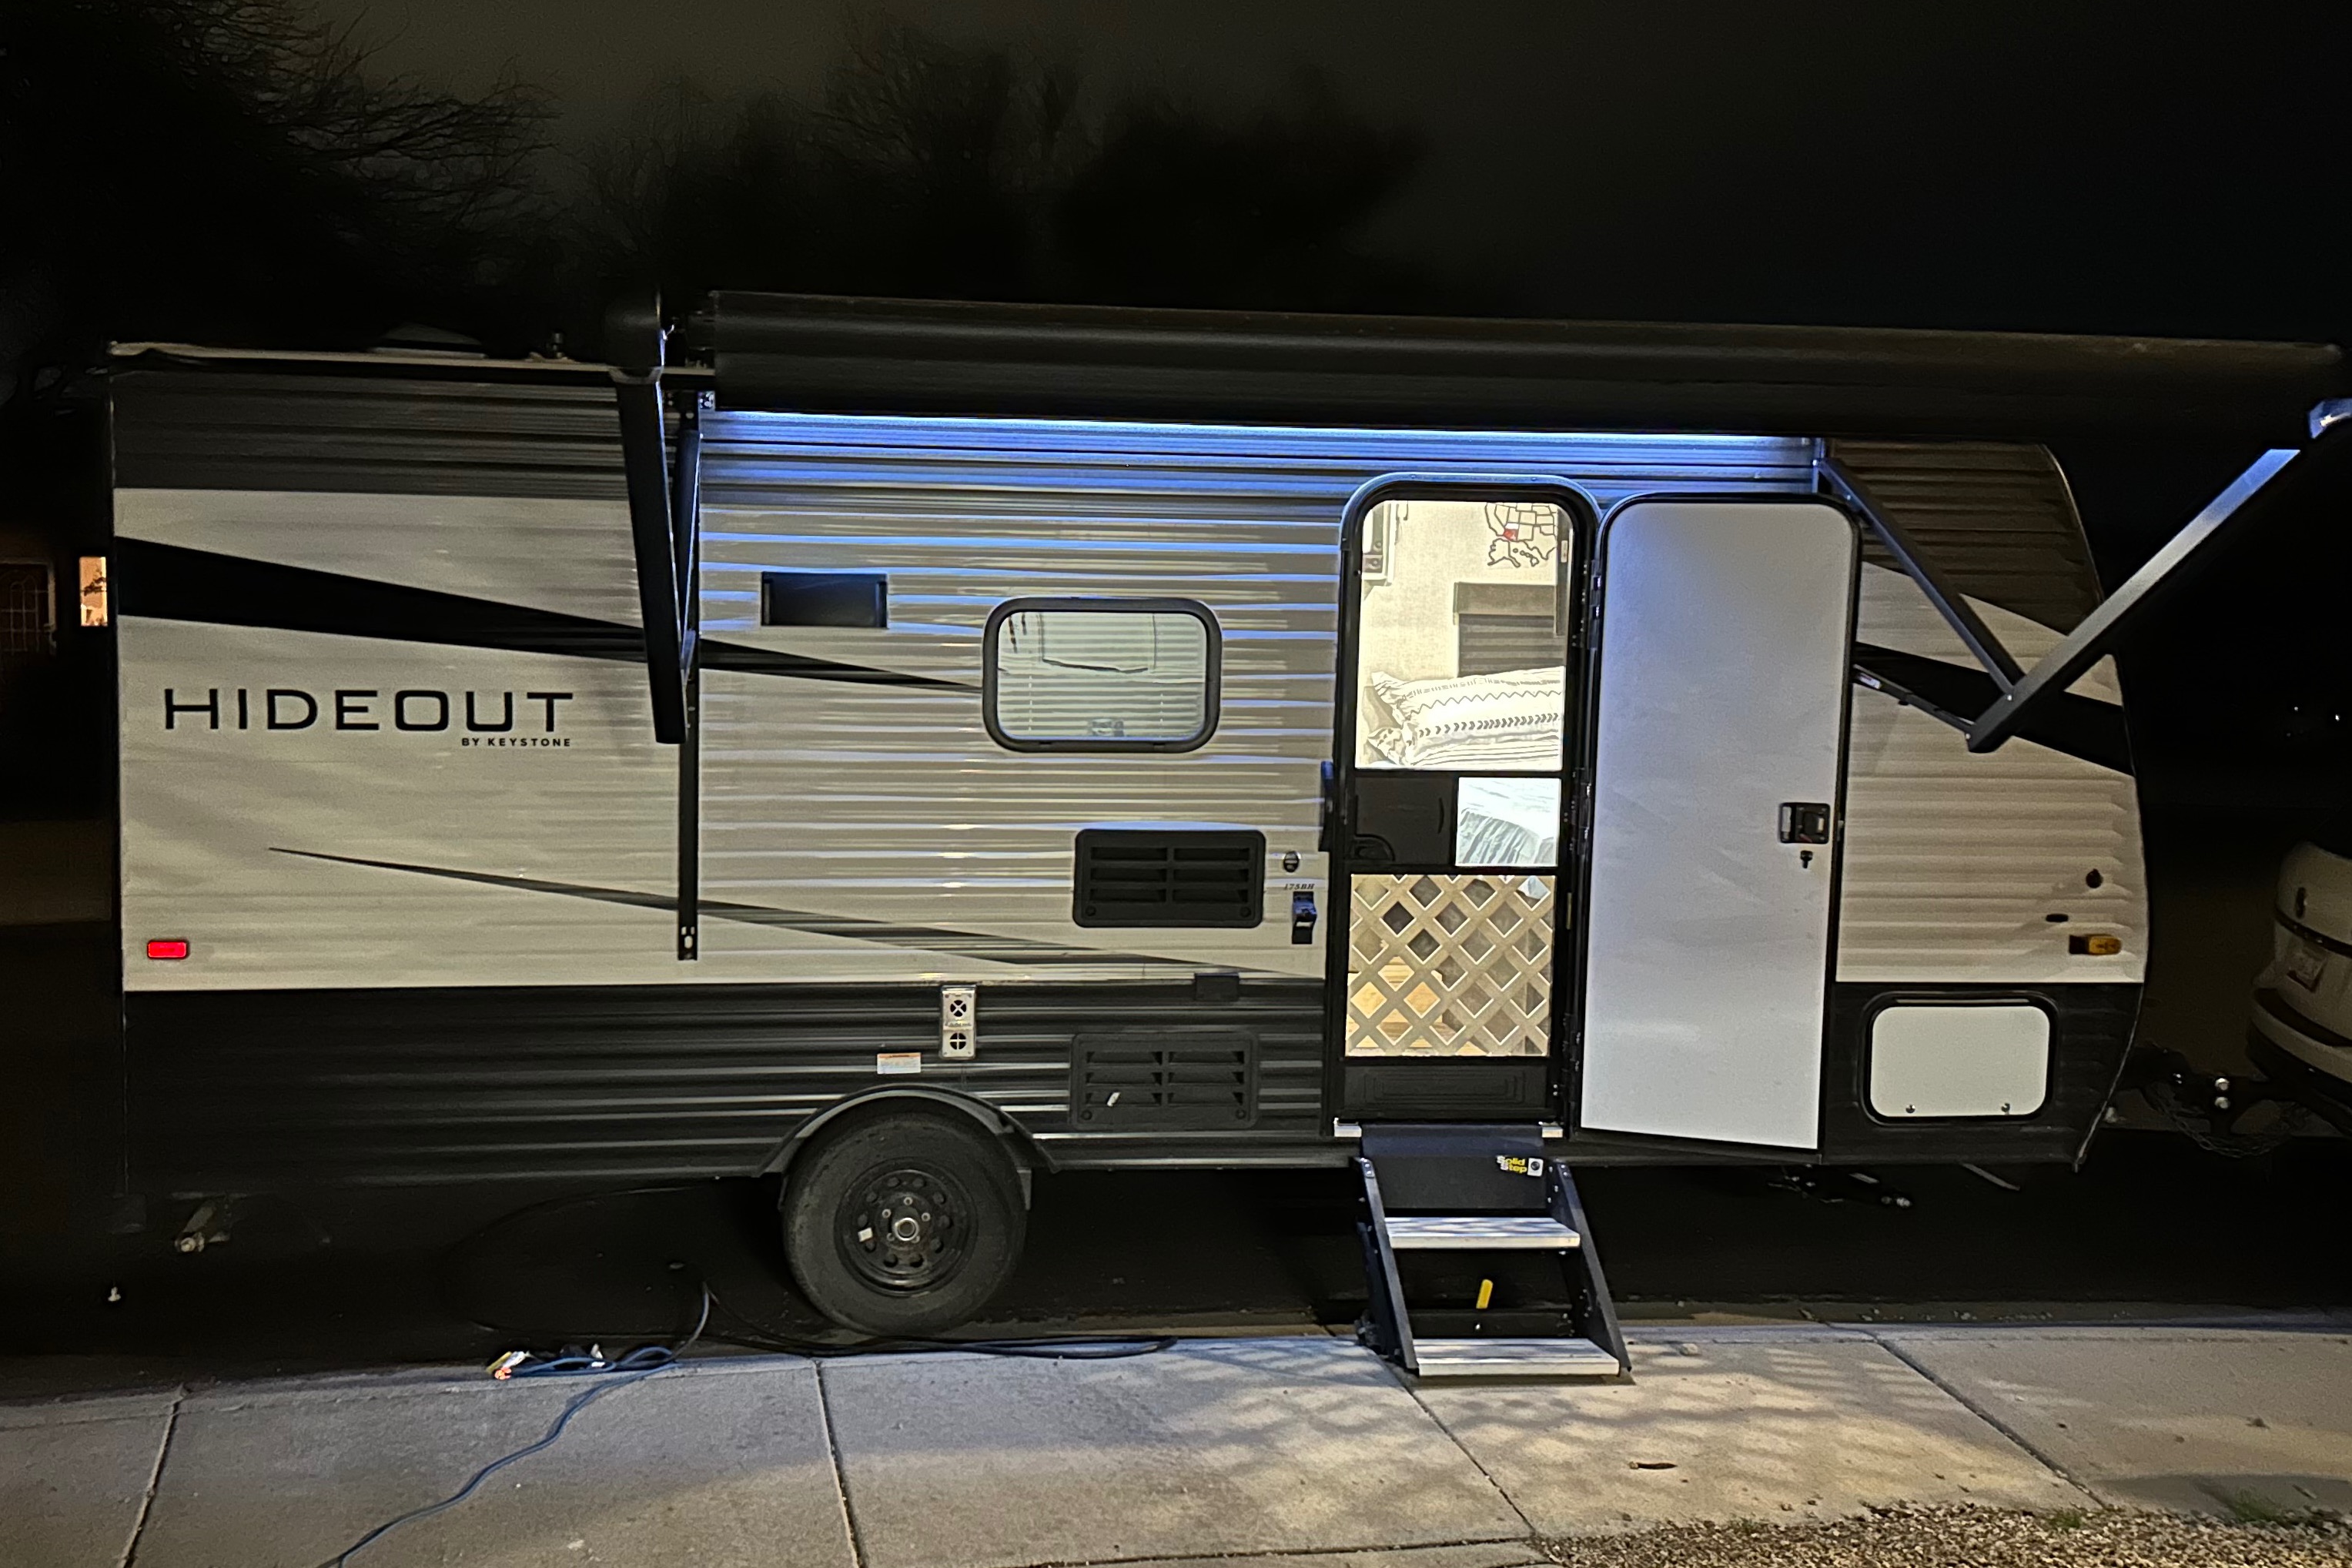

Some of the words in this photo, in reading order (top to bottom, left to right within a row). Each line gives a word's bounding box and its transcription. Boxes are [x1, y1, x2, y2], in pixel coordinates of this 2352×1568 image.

[165, 689, 573, 731] HIDEOUT
[461, 737, 480, 747] BY
[487, 737, 571, 747] KEYSTONE
